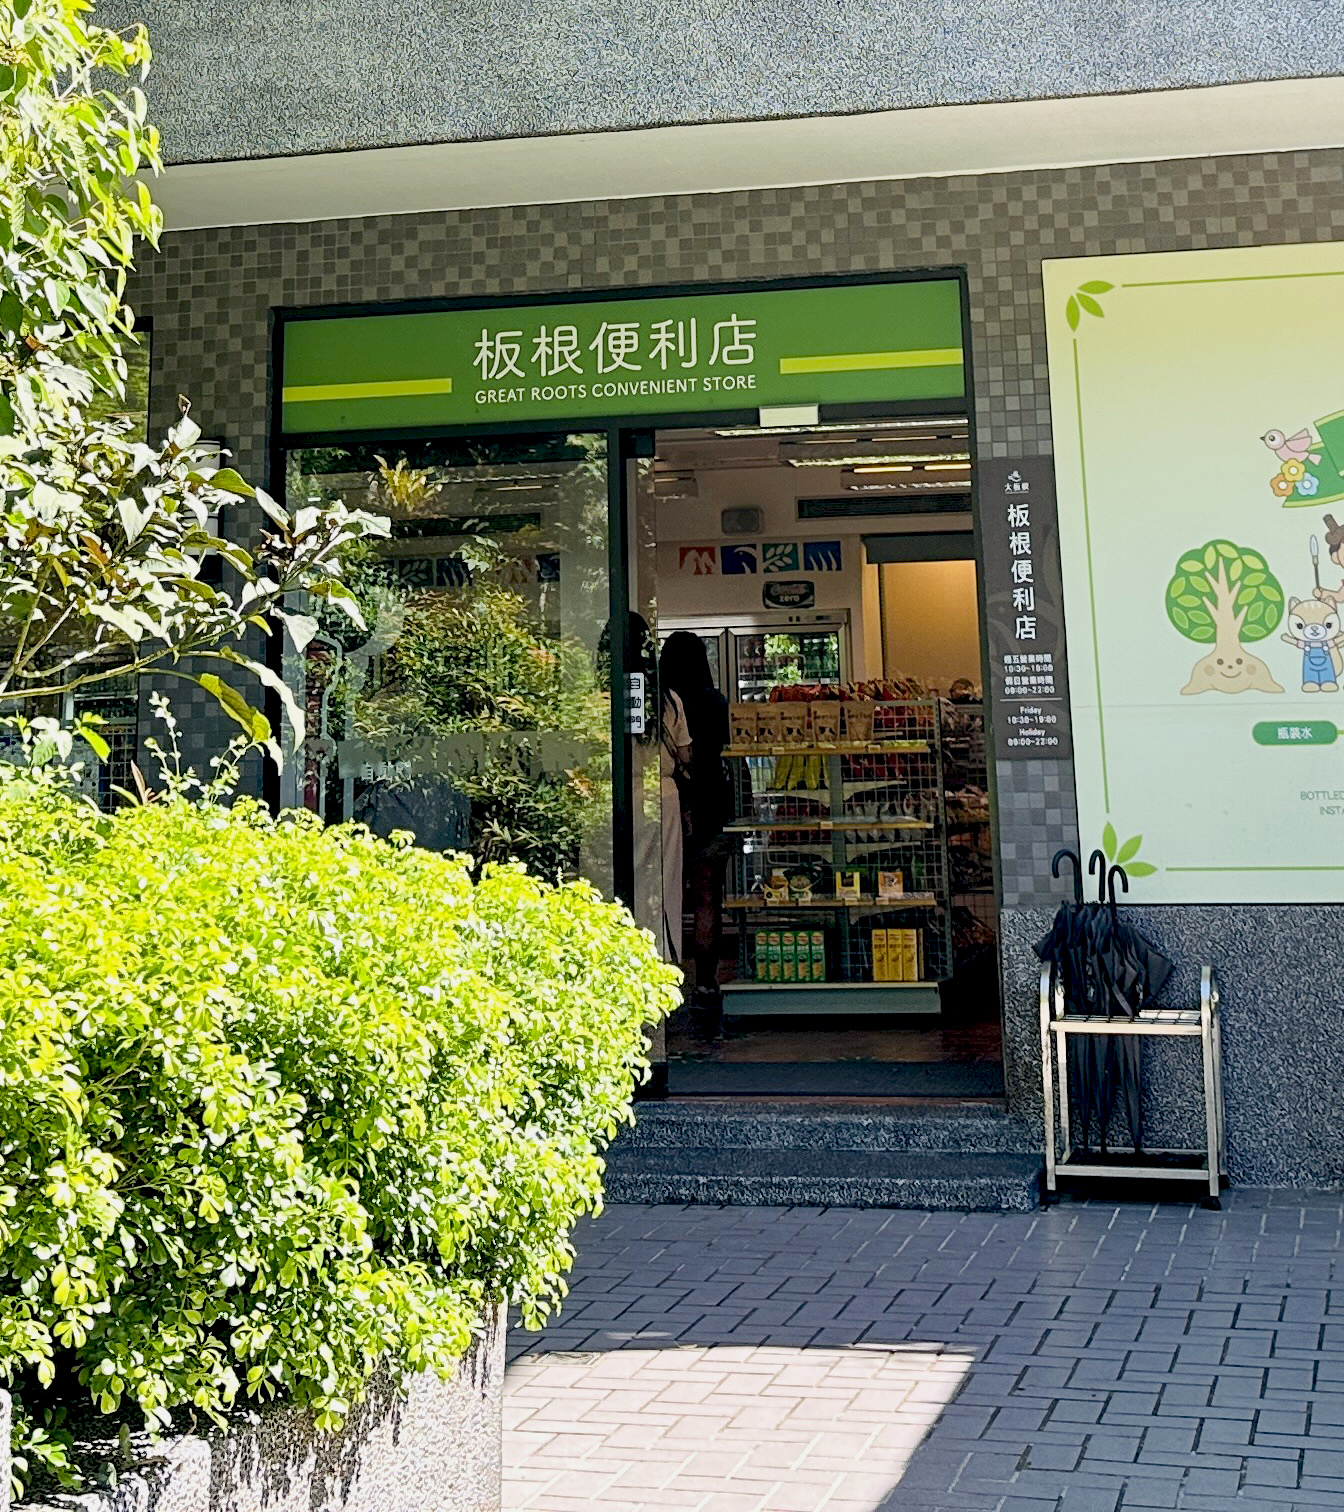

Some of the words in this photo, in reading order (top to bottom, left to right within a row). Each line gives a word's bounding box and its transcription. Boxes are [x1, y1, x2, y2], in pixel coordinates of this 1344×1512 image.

[472, 312, 758, 382] 板根便利店
[474, 386, 526, 405] GREAT
[530, 383, 588, 402] ROOTS
[590, 377, 699, 399] CONVENIENT
[702, 374, 758, 392] STORE
[1004, 482, 1030, 492] 大板根
[1007, 504, 1036, 639] 板根便利店
[779, 594, 800, 603] zero
[1019, 705, 1043, 715] Friday
[1018, 727, 1046, 737] Holiday
[1277, 726, 1314, 740] 瓶裝水
